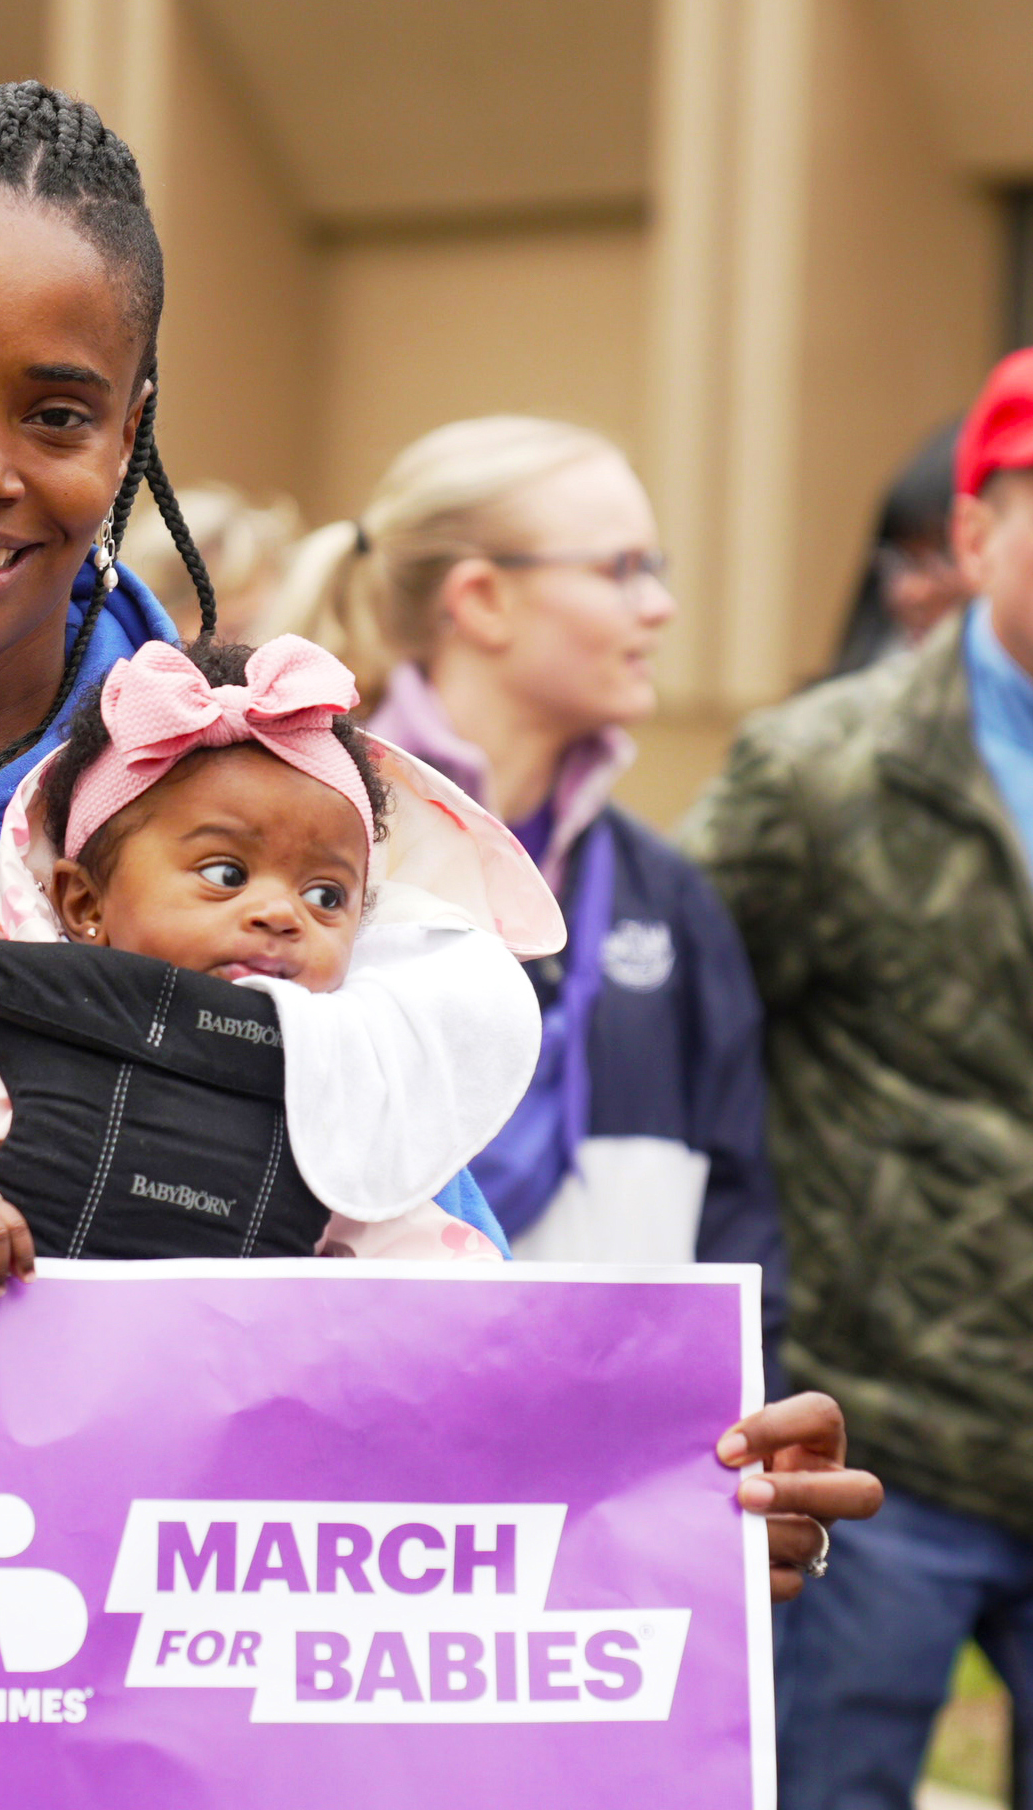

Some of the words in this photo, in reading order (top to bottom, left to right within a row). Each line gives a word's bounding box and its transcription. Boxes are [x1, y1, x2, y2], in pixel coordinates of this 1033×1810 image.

[196, 1009, 285, 1048] BABYBJÖR
[155, 1520, 517, 1595] MARCH
[154, 1629, 262, 1667] FOR
